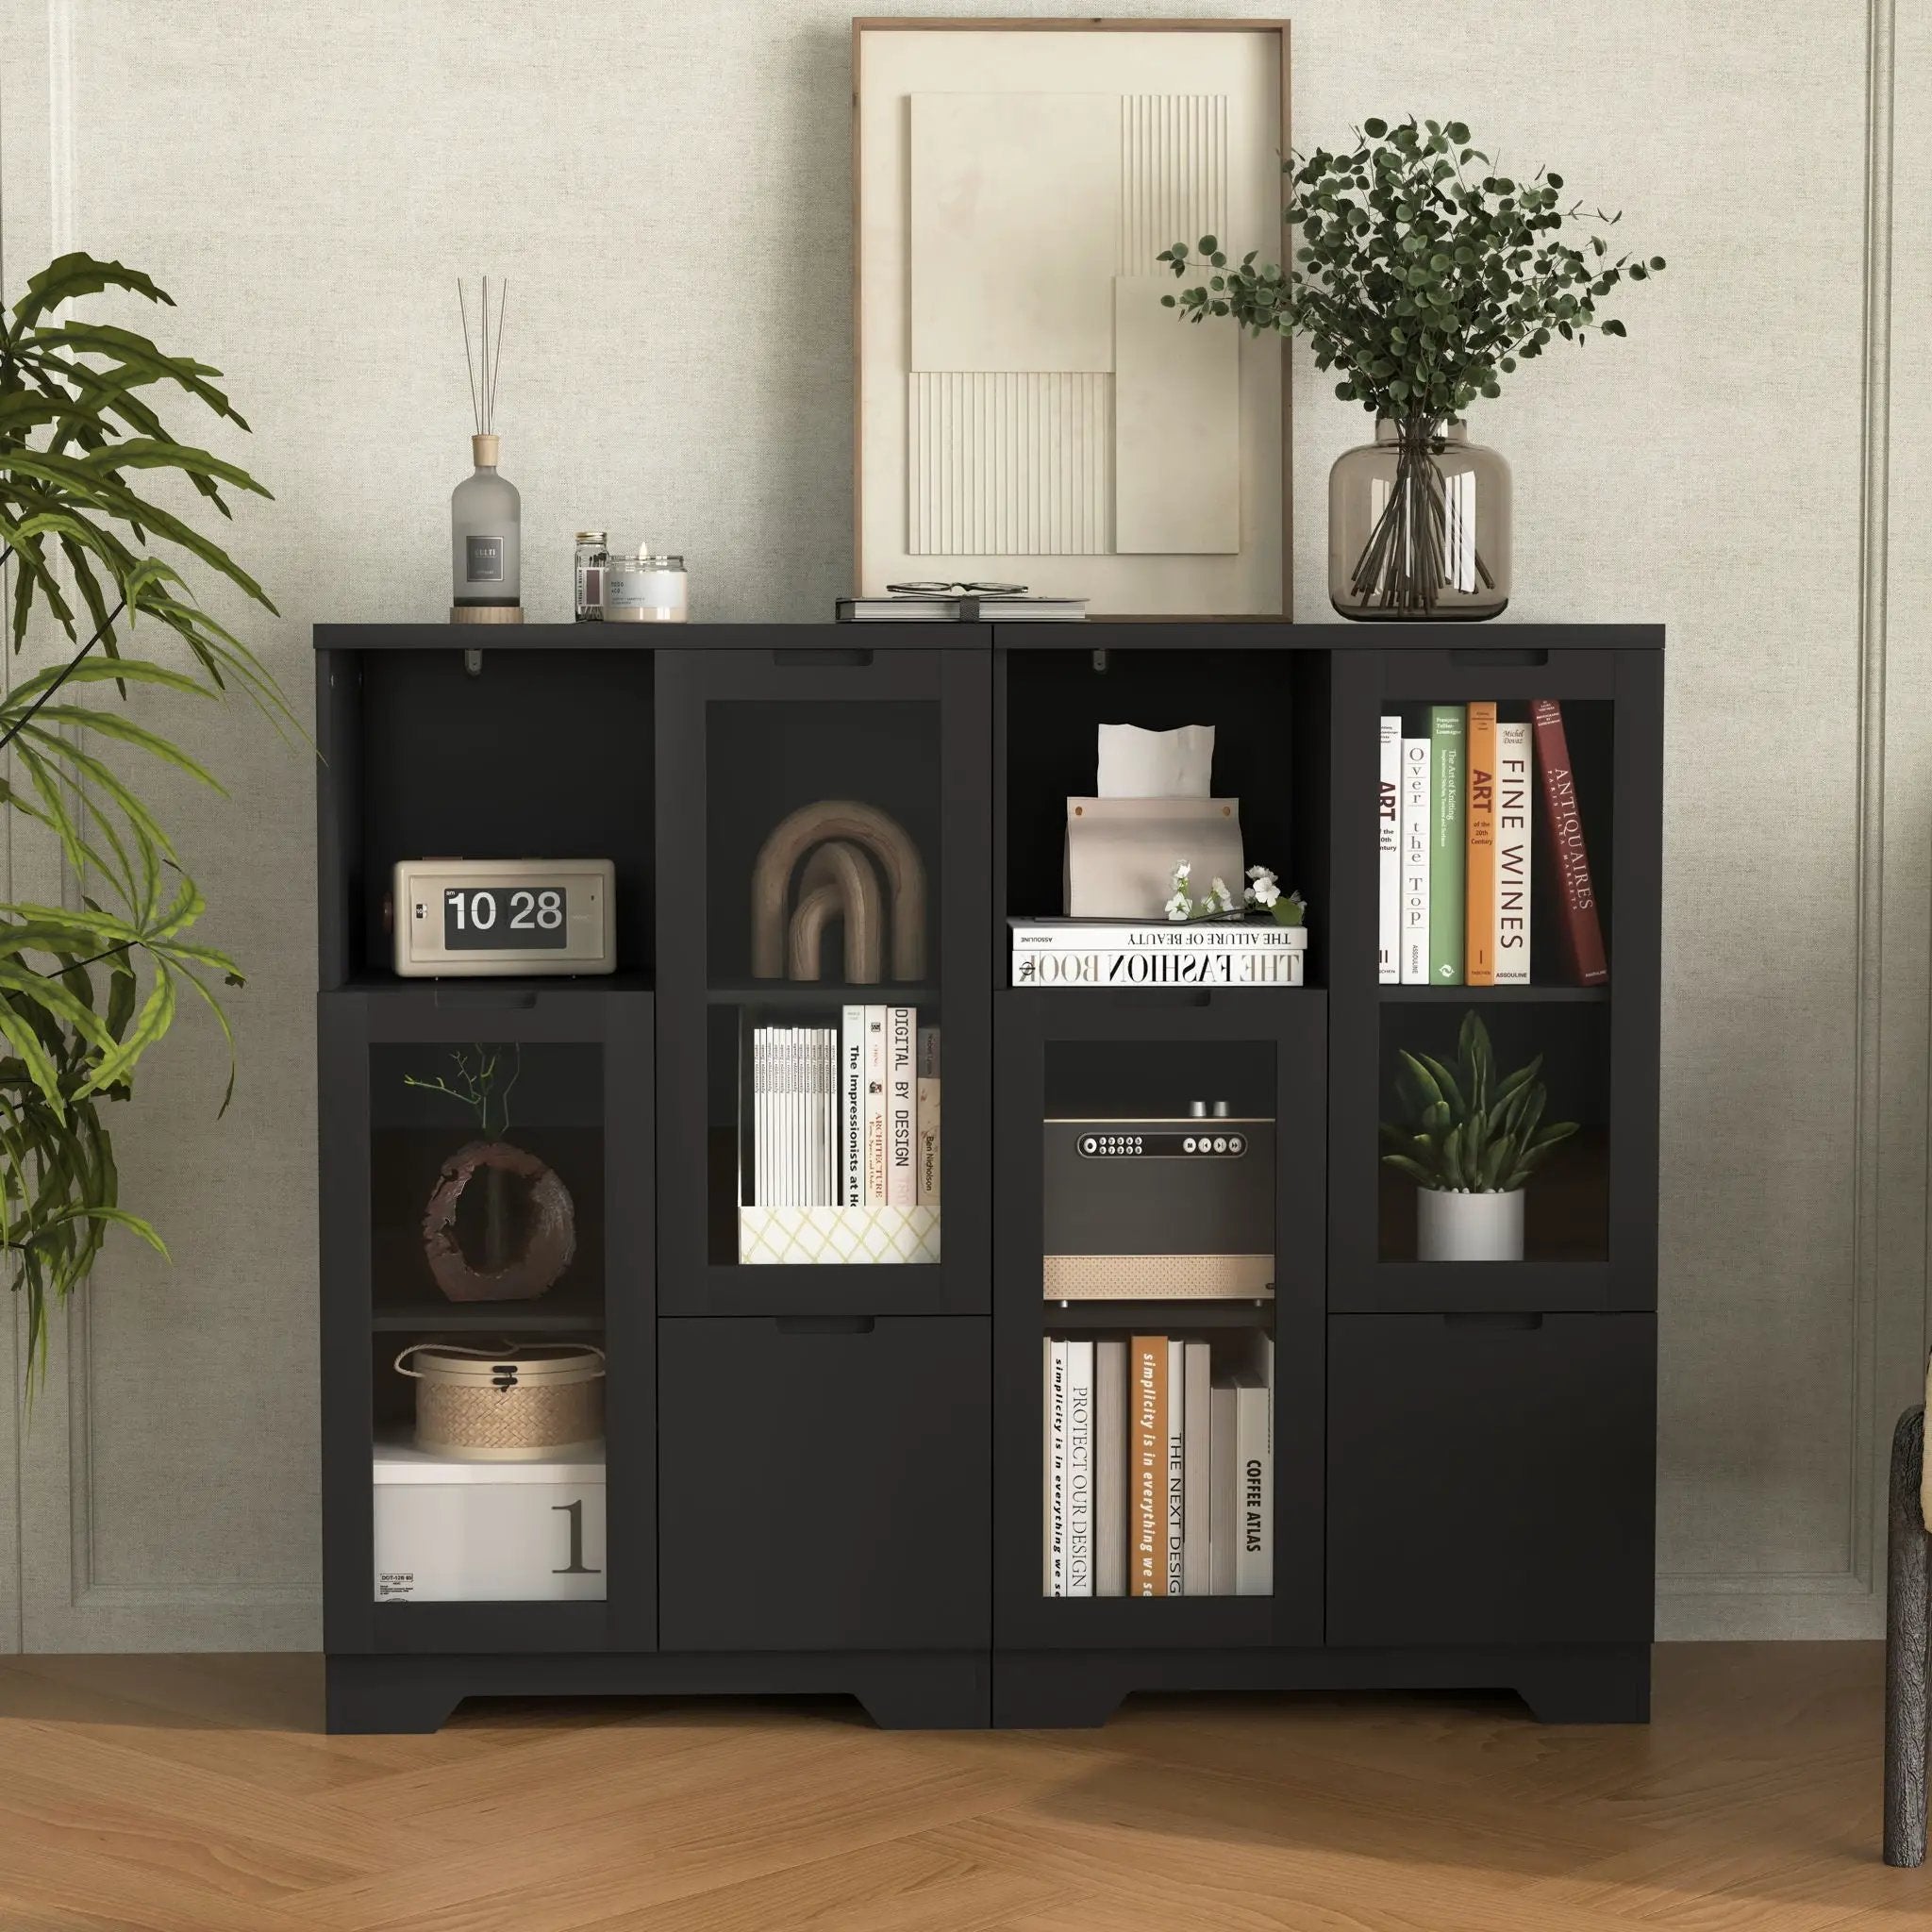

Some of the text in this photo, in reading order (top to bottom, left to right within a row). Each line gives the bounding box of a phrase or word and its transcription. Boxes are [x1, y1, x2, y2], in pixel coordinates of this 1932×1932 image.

[1448, 749, 1457, 765] The
[1448, 779, 1457, 788] of
[1380, 780, 1396, 821] ART
[1446, 790, 1457, 821] Knitting
[1473, 769, 1492, 813] ART
[1472, 838, 1493, 846] Century
[1500, 760, 1524, 949] FINE WINES
[1548, 770, 1559, 807] PARIS
[1562, 855, 1578, 911] MARKETS
[1554, 767, 1594, 910] ANTIQUAIRES
[448, 891, 563, 930] 10 28
[1127, 932, 1291, 945] THE ALLURE OF BEAUTY
[894, 1008, 908, 1071] DIGITAL
[894, 1081, 908, 1099] BY
[848, 1045, 859, 1207] The Impressionists at Ho
[874, 1112, 883, 1198] ARCHITECTURE
[894, 1109, 909, 1167] DESIGN
[926, 1153, 935, 1191] Nicholson
[1053, 1358, 1064, 1596] simplicity is in everything we se
[1071, 1386, 1088, 1588] PROTECT OUR DESIGN
[1140, 1353, 1157, 1596] simplicity is in everything we se
[1246, 1459, 1262, 1552] COFFEE ATLAS
[551, 1498, 602, 1574] 1
[1169, 1432, 1182, 1594] THE NEXT DESIG
